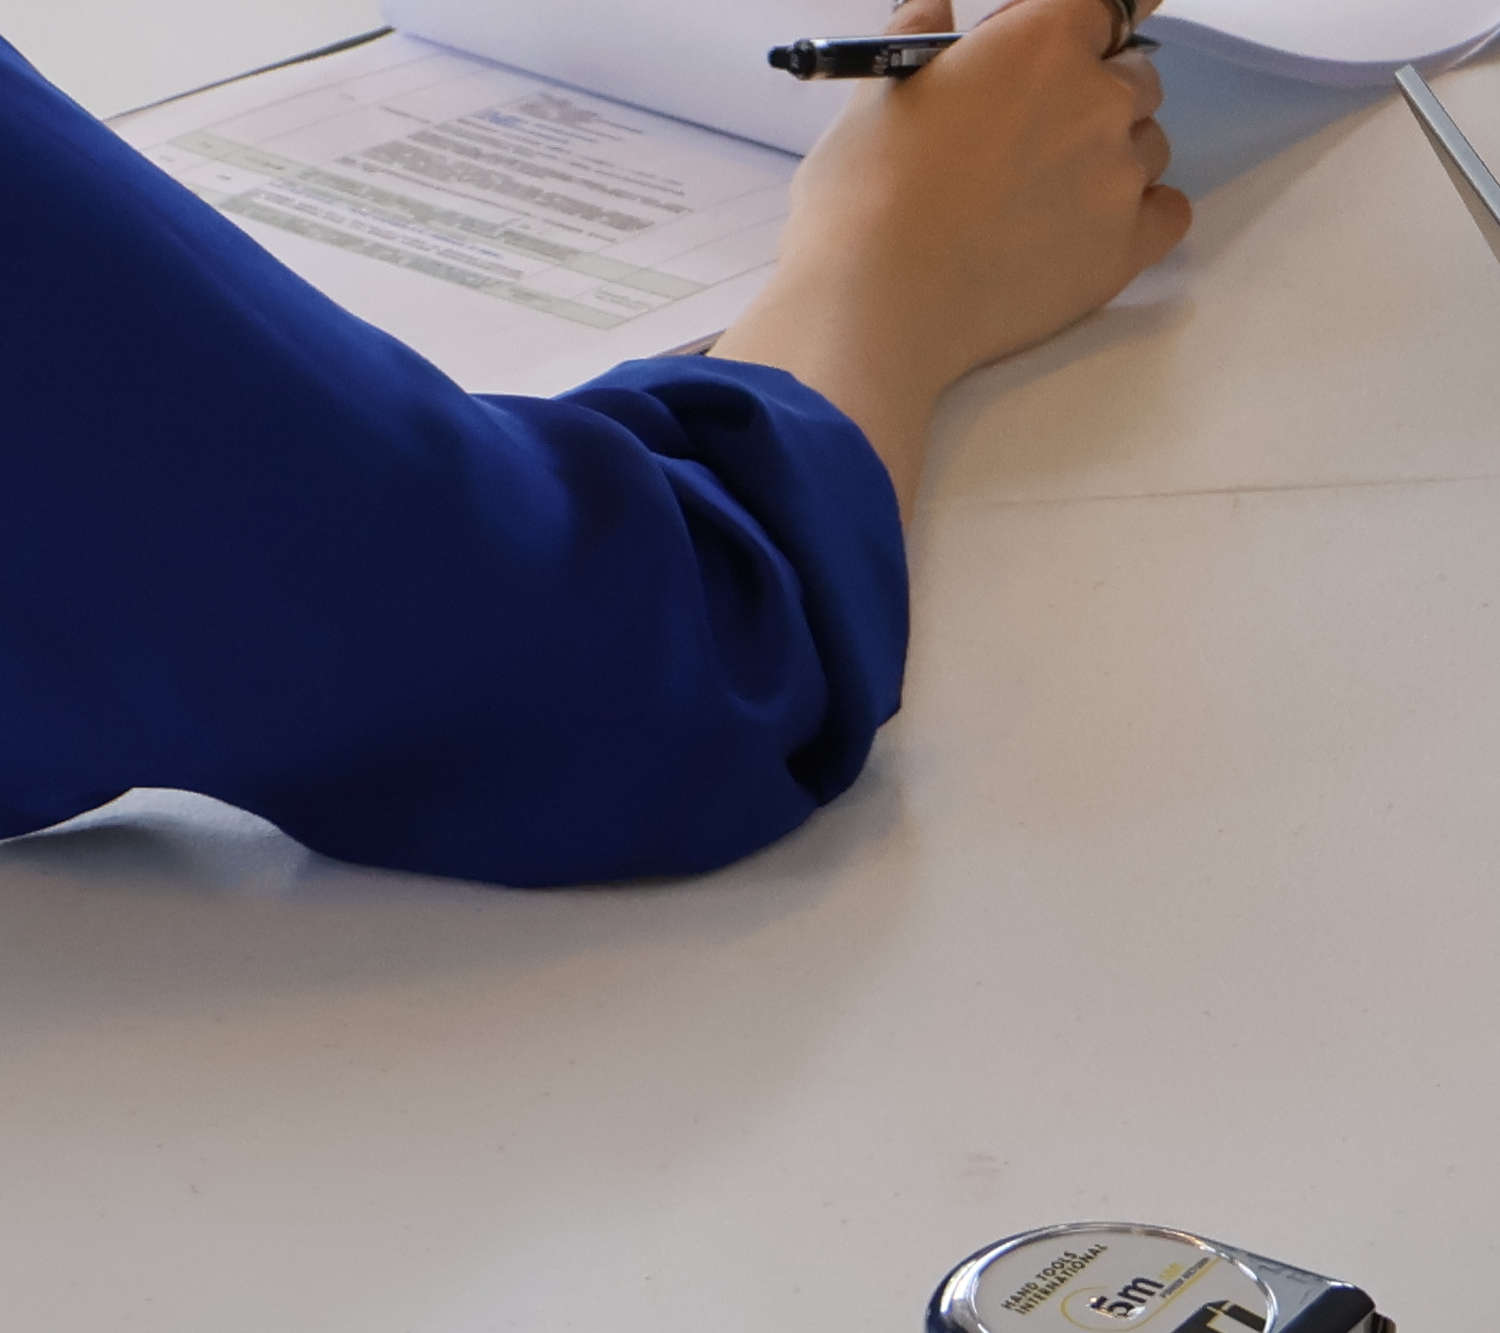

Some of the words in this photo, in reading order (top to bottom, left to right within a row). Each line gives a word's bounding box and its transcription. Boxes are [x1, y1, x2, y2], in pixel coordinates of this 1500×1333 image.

[1001, 1281, 1039, 1310] HAND
[1036, 1251, 1078, 1283] TOOLS
[1015, 1243, 1108, 1315] INTERNATIONAL
[1090, 1276, 1164, 1319] 5m
